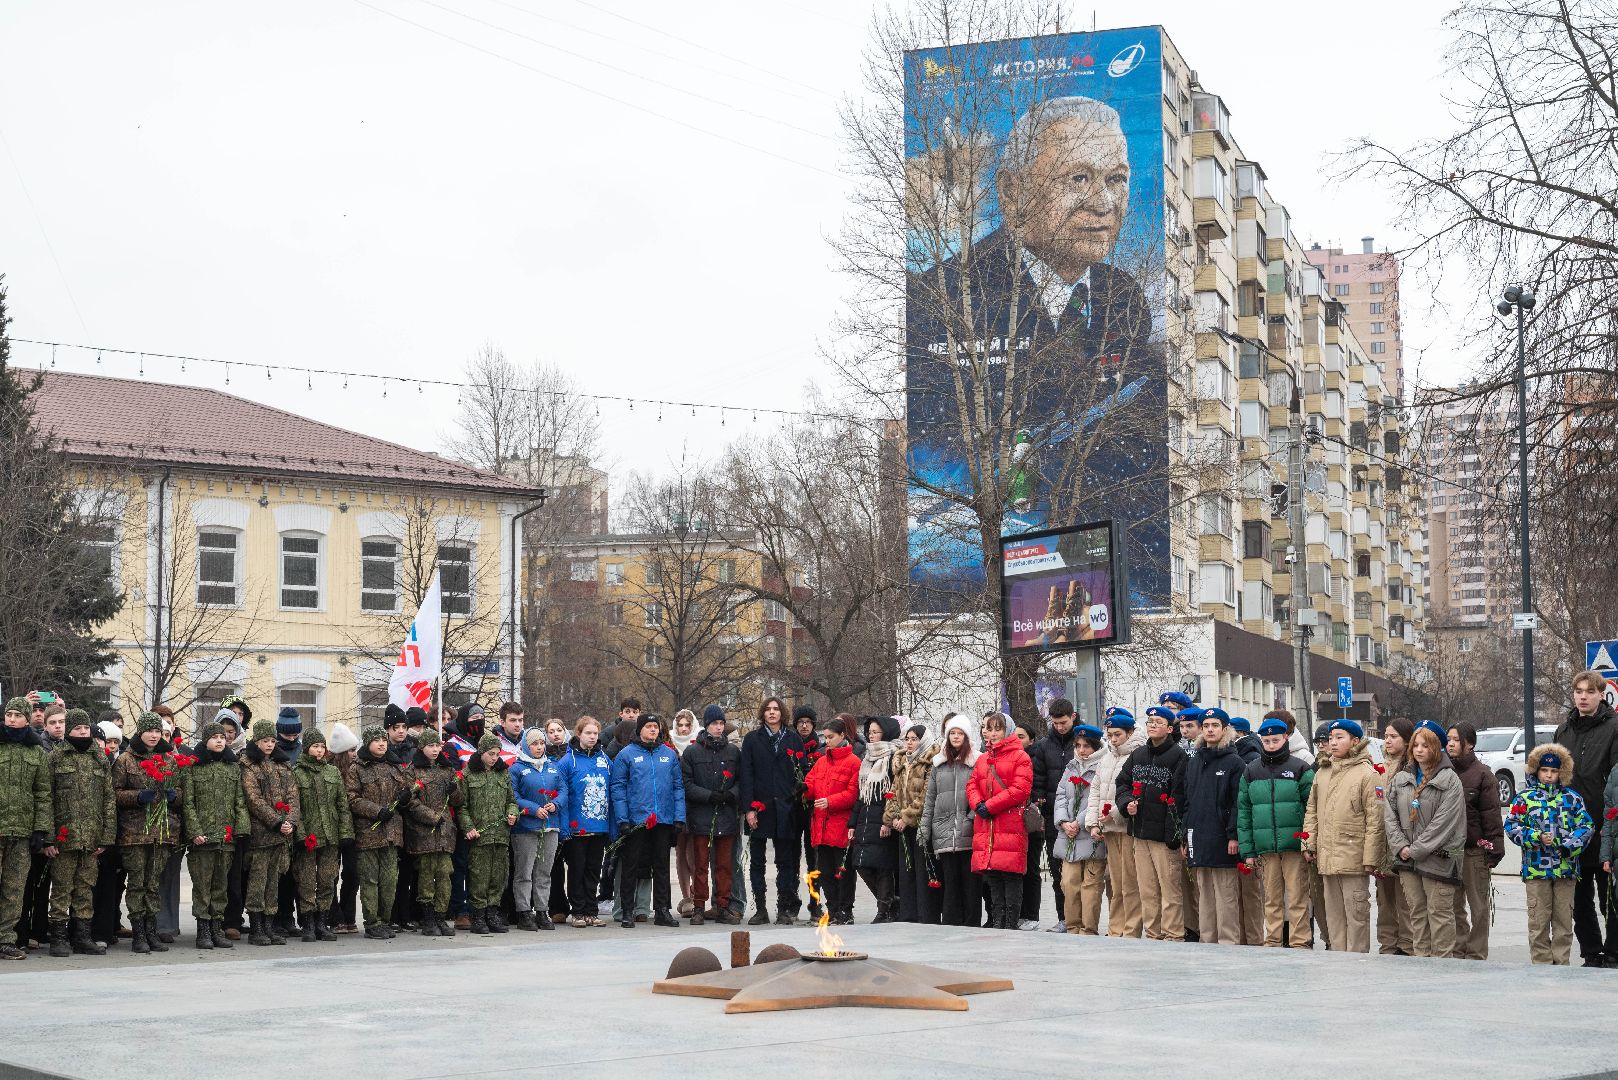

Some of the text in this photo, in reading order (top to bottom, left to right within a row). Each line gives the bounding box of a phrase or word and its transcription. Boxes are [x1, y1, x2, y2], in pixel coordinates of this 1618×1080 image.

[1013, 610, 1107, 633] Всё ищите на wb
[1182, 681, 1195, 695] 20
